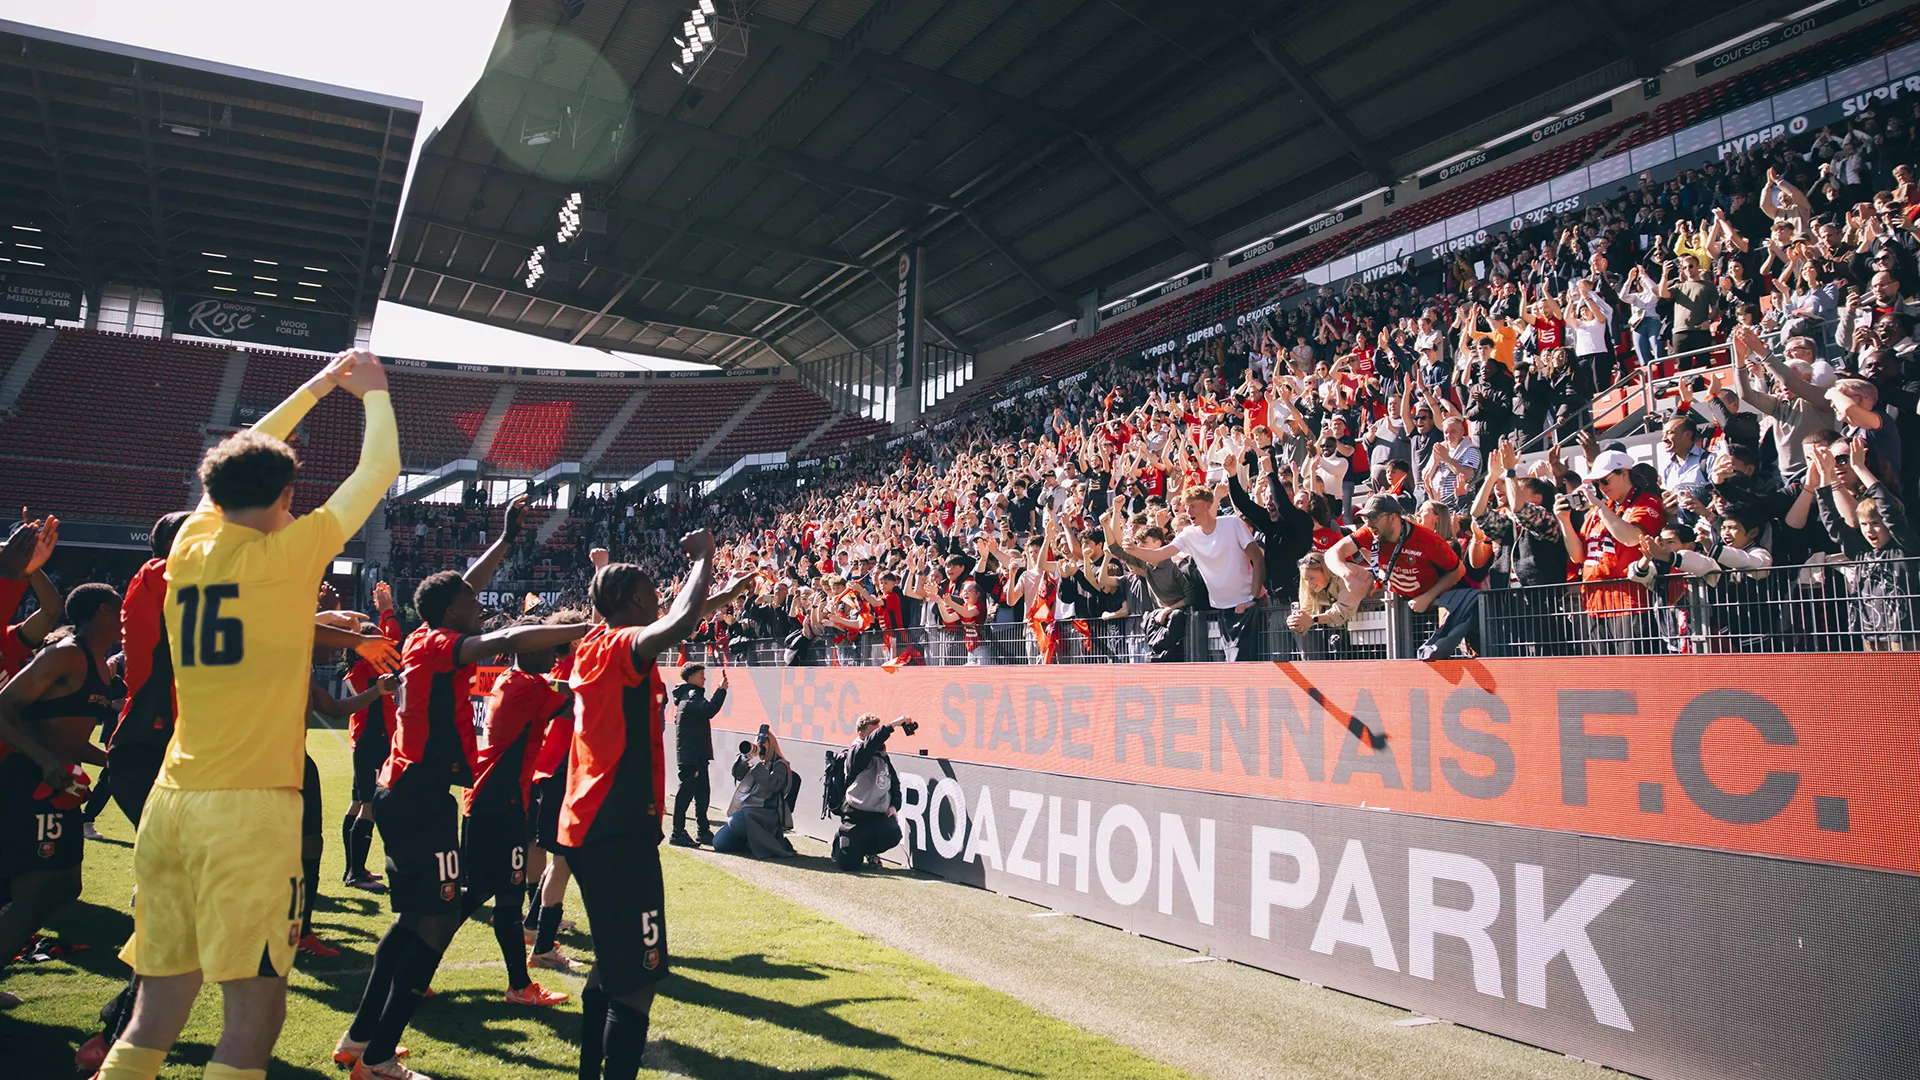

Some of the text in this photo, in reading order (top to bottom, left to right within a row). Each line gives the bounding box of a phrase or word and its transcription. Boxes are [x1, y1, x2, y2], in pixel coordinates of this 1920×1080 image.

[1713, 35, 1770, 67] courses
[1543, 111, 1586, 136] express
[1450, 152, 1486, 175] express
[1308, 215, 1336, 234] SUPER
[1243, 245, 1267, 261] SUPER
[1431, 233, 1475, 260] SUPER
[1161, 279, 1182, 295] HYPER
[188, 300, 256, 337] Rose
[223, 302, 257, 313] GROUPE
[1112, 302, 1132, 316] HYPER
[275, 326, 310, 337] FOR LIFE
[280, 319, 307, 330] WOOD
[896, 280, 907, 360] HYPER
[1186, 326, 1214, 345] SUPER
[394, 359, 420, 368] HYPER
[457, 364, 482, 372] HYPER
[676, 371, 700, 379] express
[732, 369, 756, 377] express
[176, 583, 244, 667] 16
[940, 683, 1851, 833] STADE RENNAIS F.C.
[35, 813, 63, 841] 15
[435, 850, 459, 881] 10
[511, 846, 523, 870] 6
[900, 772, 1636, 1033] ROAZHON PARK
[642, 910, 659, 947] 5
